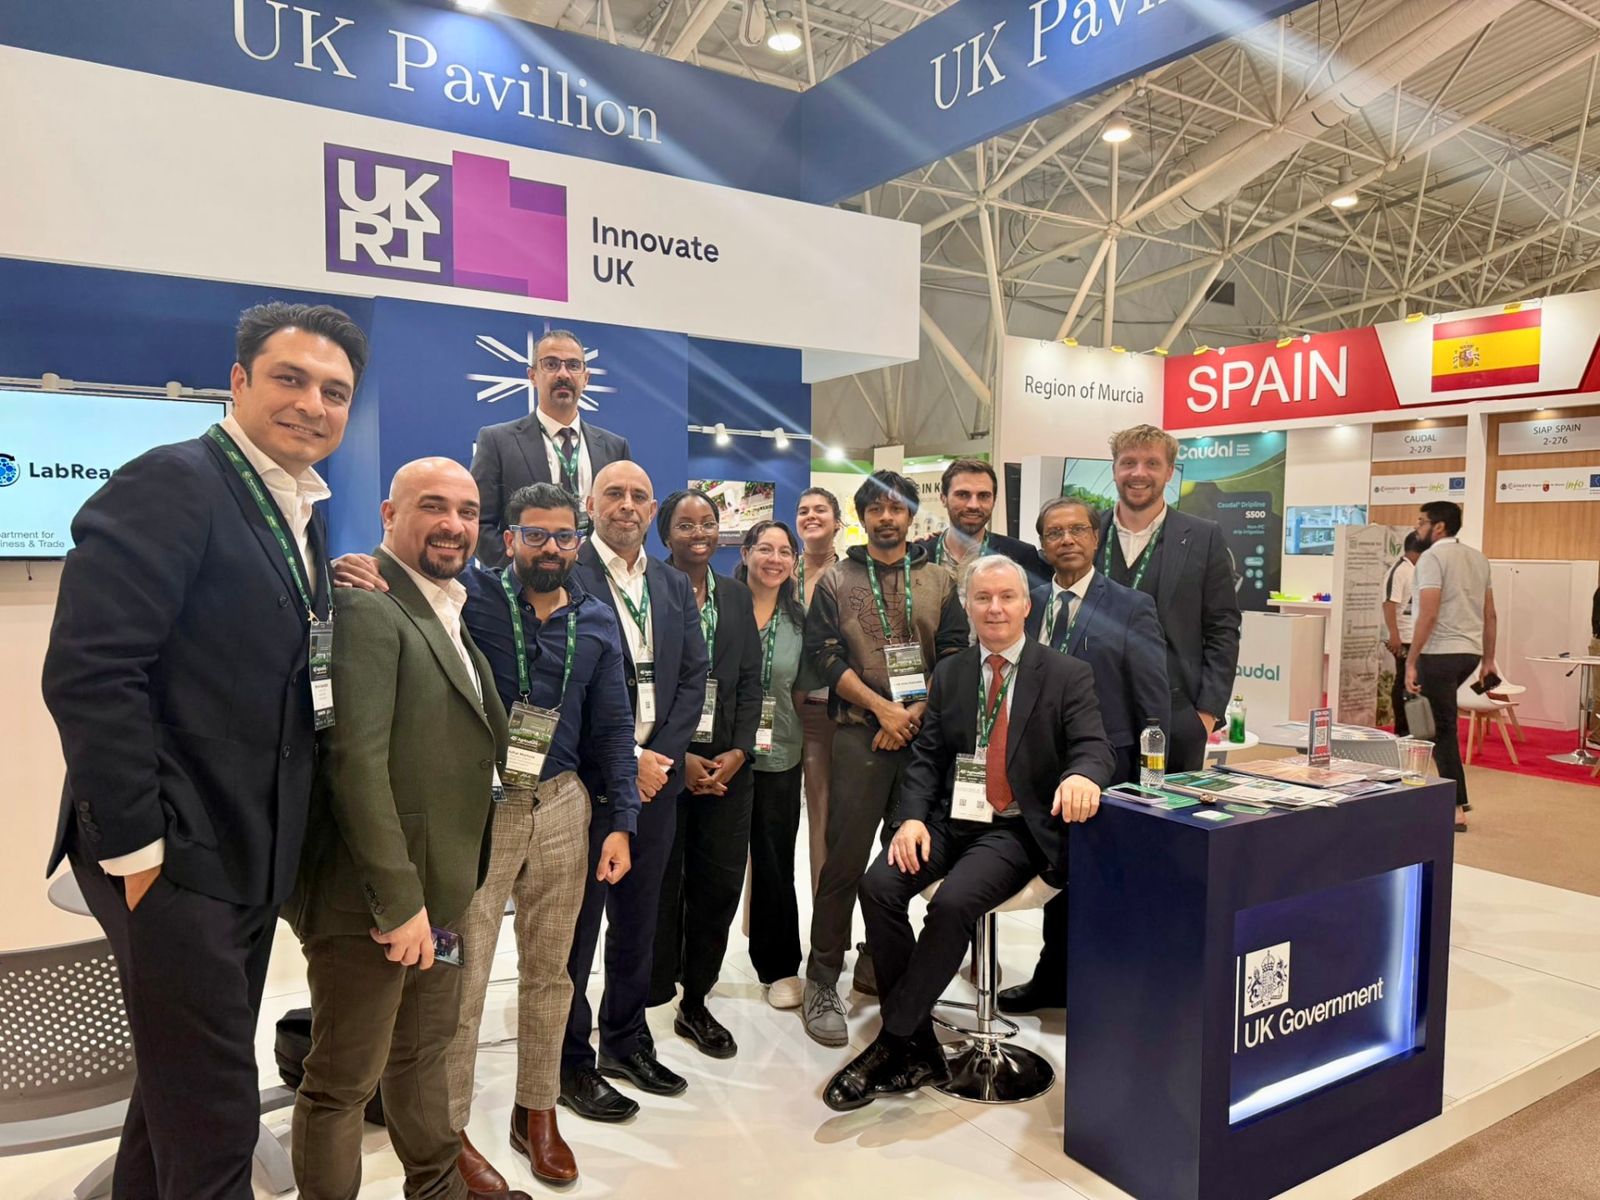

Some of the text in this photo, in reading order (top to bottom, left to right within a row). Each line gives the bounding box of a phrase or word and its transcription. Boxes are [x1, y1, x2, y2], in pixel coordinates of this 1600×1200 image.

[930, 0, 1167, 110] UK Pav
[233, 0, 662, 144] UK Pavillion
[592, 217, 720, 263] Innovate
[592, 257, 635, 288] UK
[1186, 345, 1348, 413] SPAIN
[1024, 375, 1144, 404] Region of Murcia
[1533, 423, 1582, 435] SIAP SPAIN
[1404, 434, 1437, 443] CAUDAL
[1543, 436, 1568, 446] 2-276
[1177, 440, 1234, 460] Caudal
[1409, 445, 1432, 454] 2-278
[29, 462, 116, 480] LabRea
[922, 483, 932, 494] IN
[1245, 510, 1266, 519] S500
[0, 531, 55, 539] artment for
[28, 540, 36, 548] &
[38, 540, 65, 548] Trade
[1244, 977, 1384, 1048] UK Government
